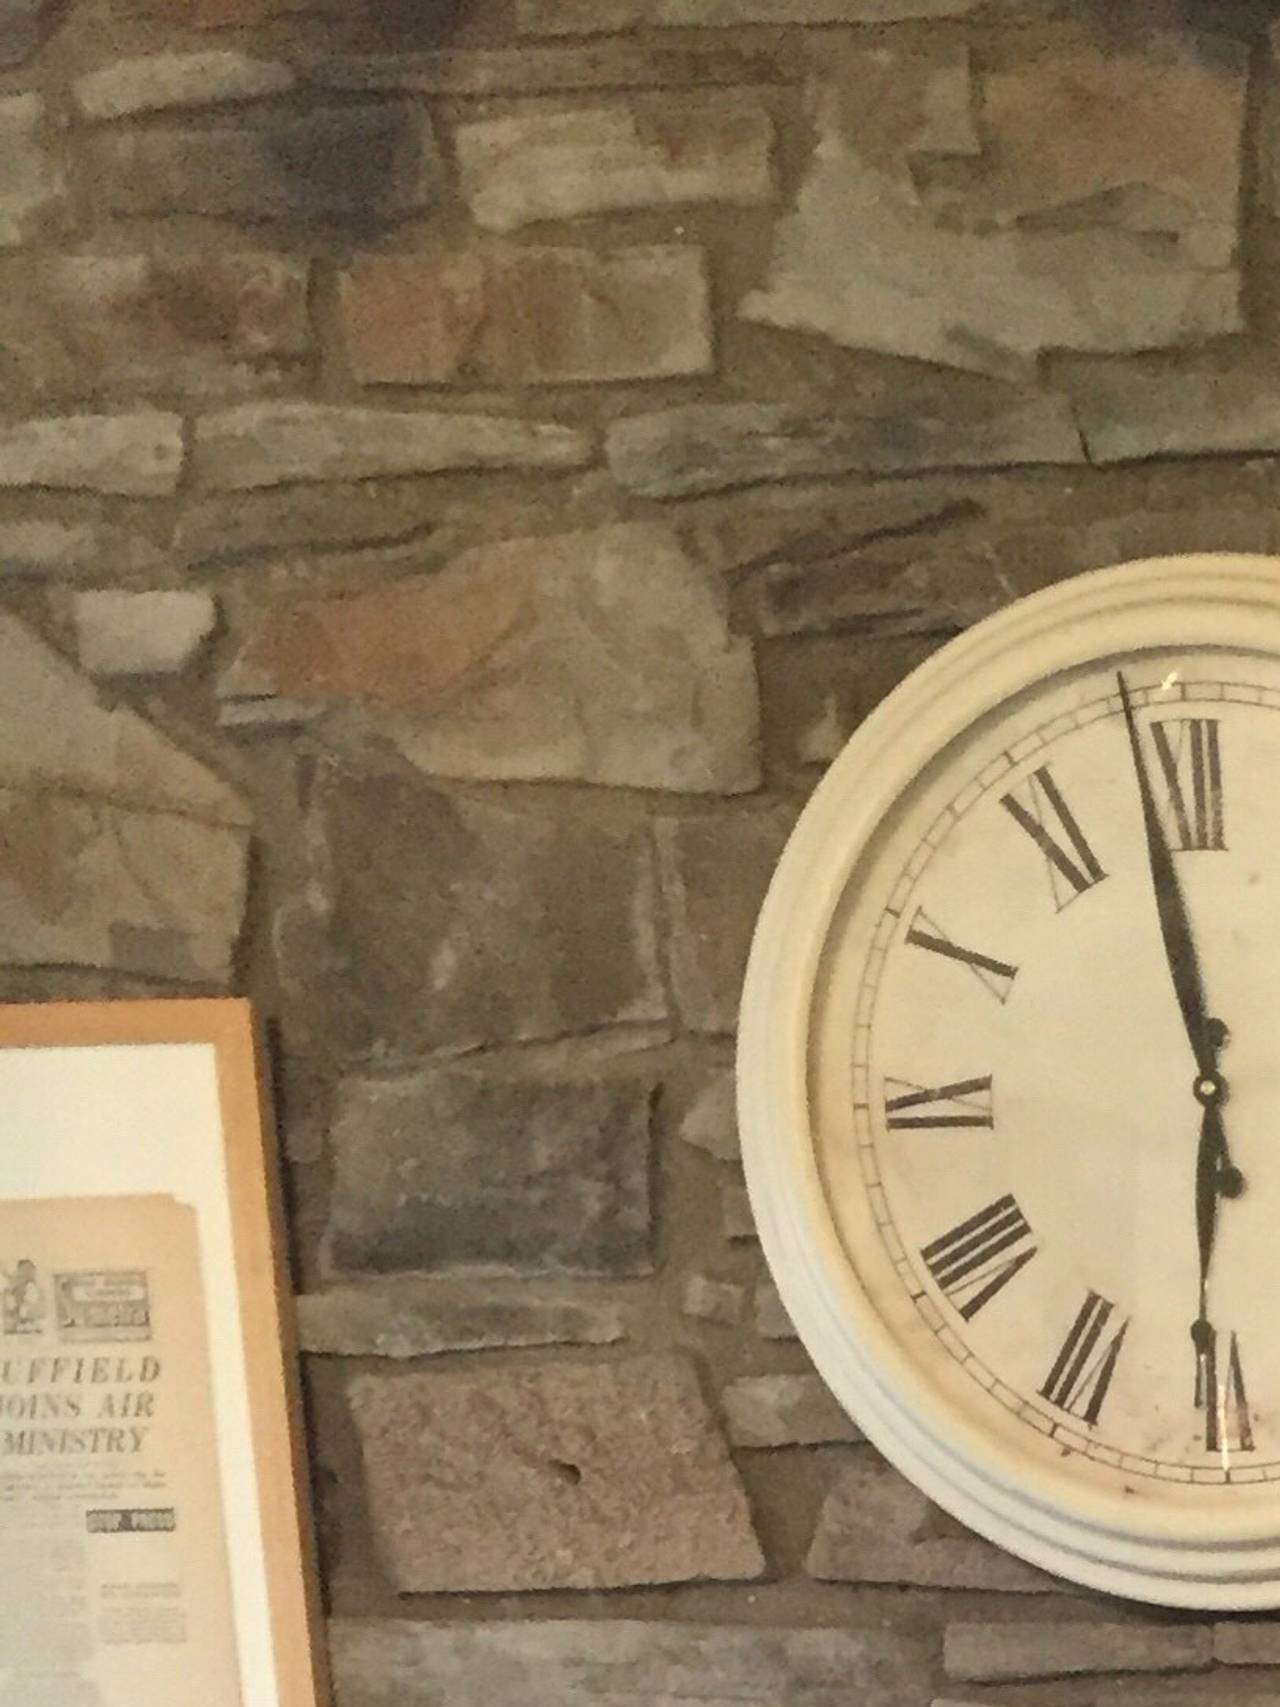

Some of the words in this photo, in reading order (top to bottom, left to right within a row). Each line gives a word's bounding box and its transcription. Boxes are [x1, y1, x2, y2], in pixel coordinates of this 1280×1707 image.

[1000, 764, 1108, 913] XI
[1149, 718, 1227, 851] XII
[905, 907, 1019, 1004] X
[884, 1074, 995, 1130] IX
[919, 1193, 1038, 1322] VIII
[0, 1393, 81, 1420] OINS
[98, 1392, 154, 1418] AIR
[1038, 1290, 1131, 1429] VII
[1, 1425, 150, 1455] MINISTRY
